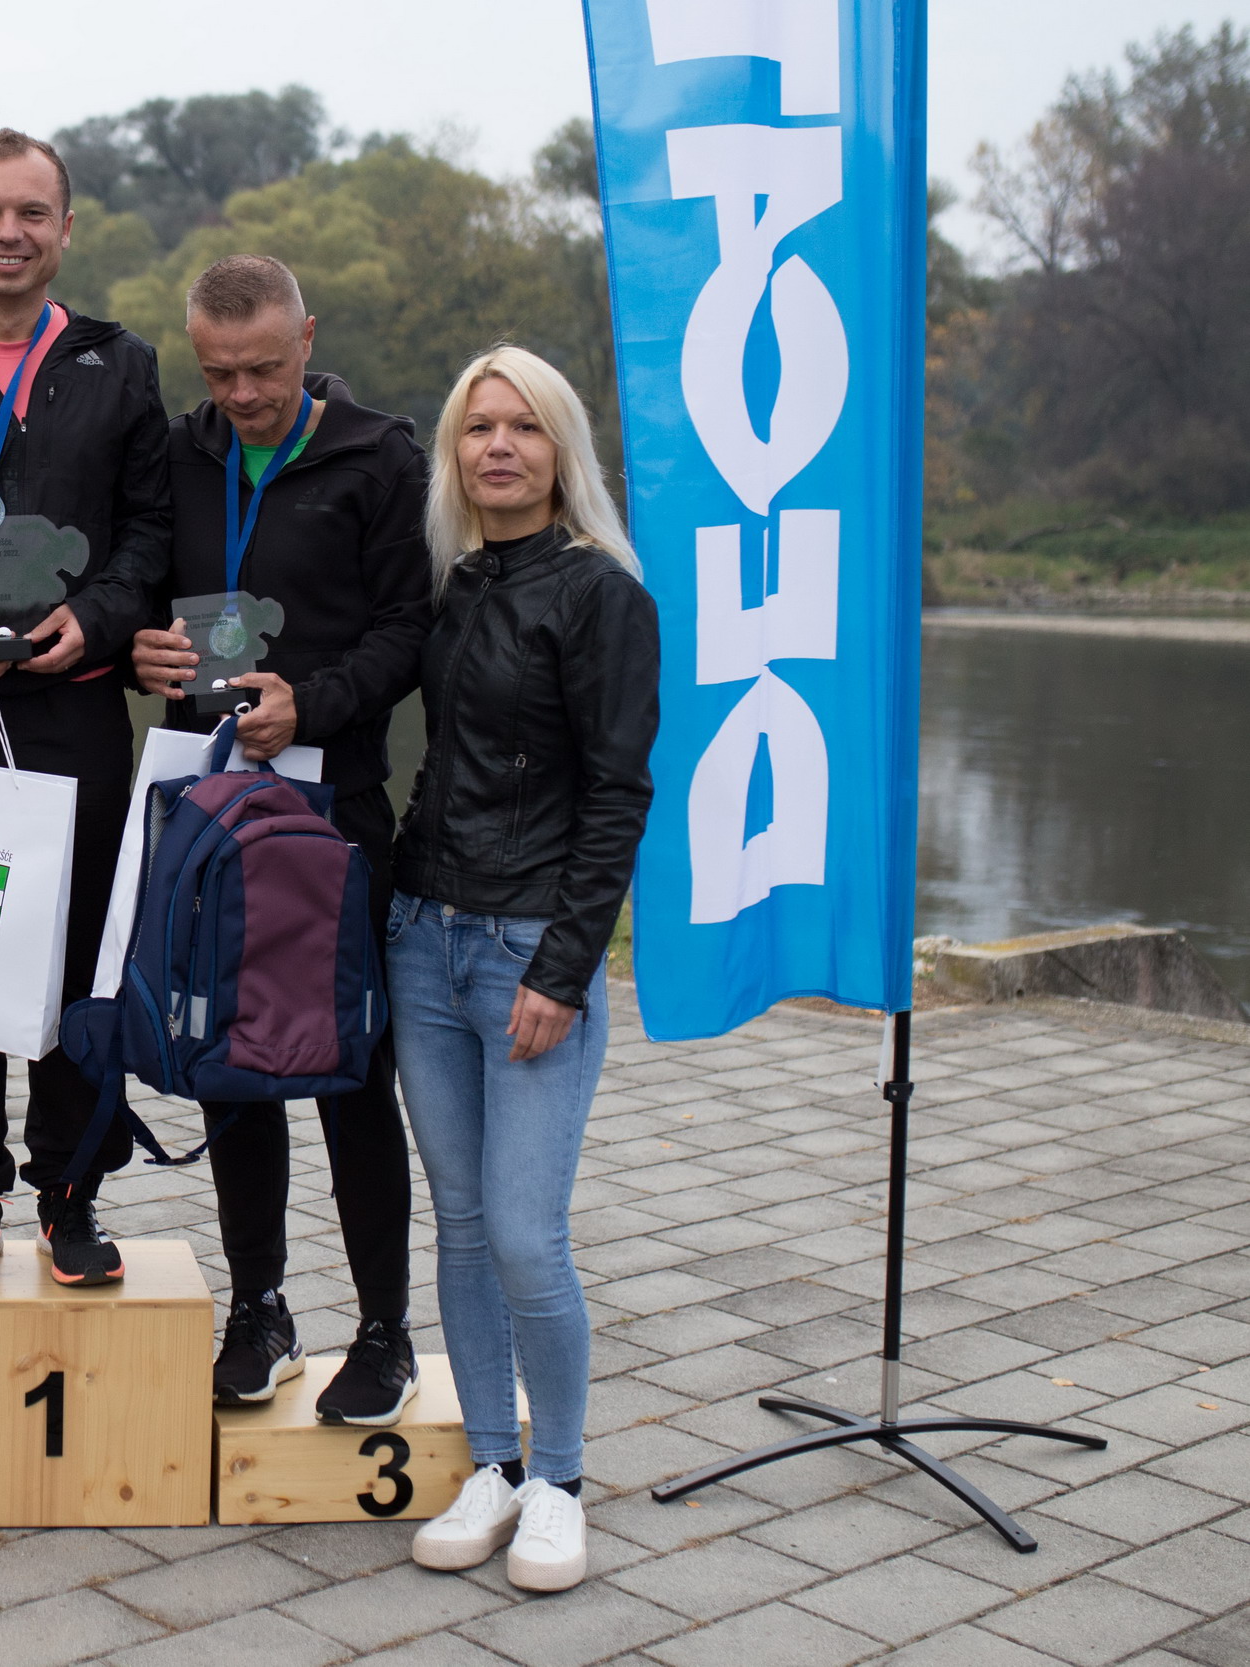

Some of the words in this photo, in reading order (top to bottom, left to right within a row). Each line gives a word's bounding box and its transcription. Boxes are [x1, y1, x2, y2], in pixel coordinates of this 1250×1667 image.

[76, 357, 104, 366] adidas
[24, 1371, 65, 1458] 1
[356, 1432, 414, 1518] 3
